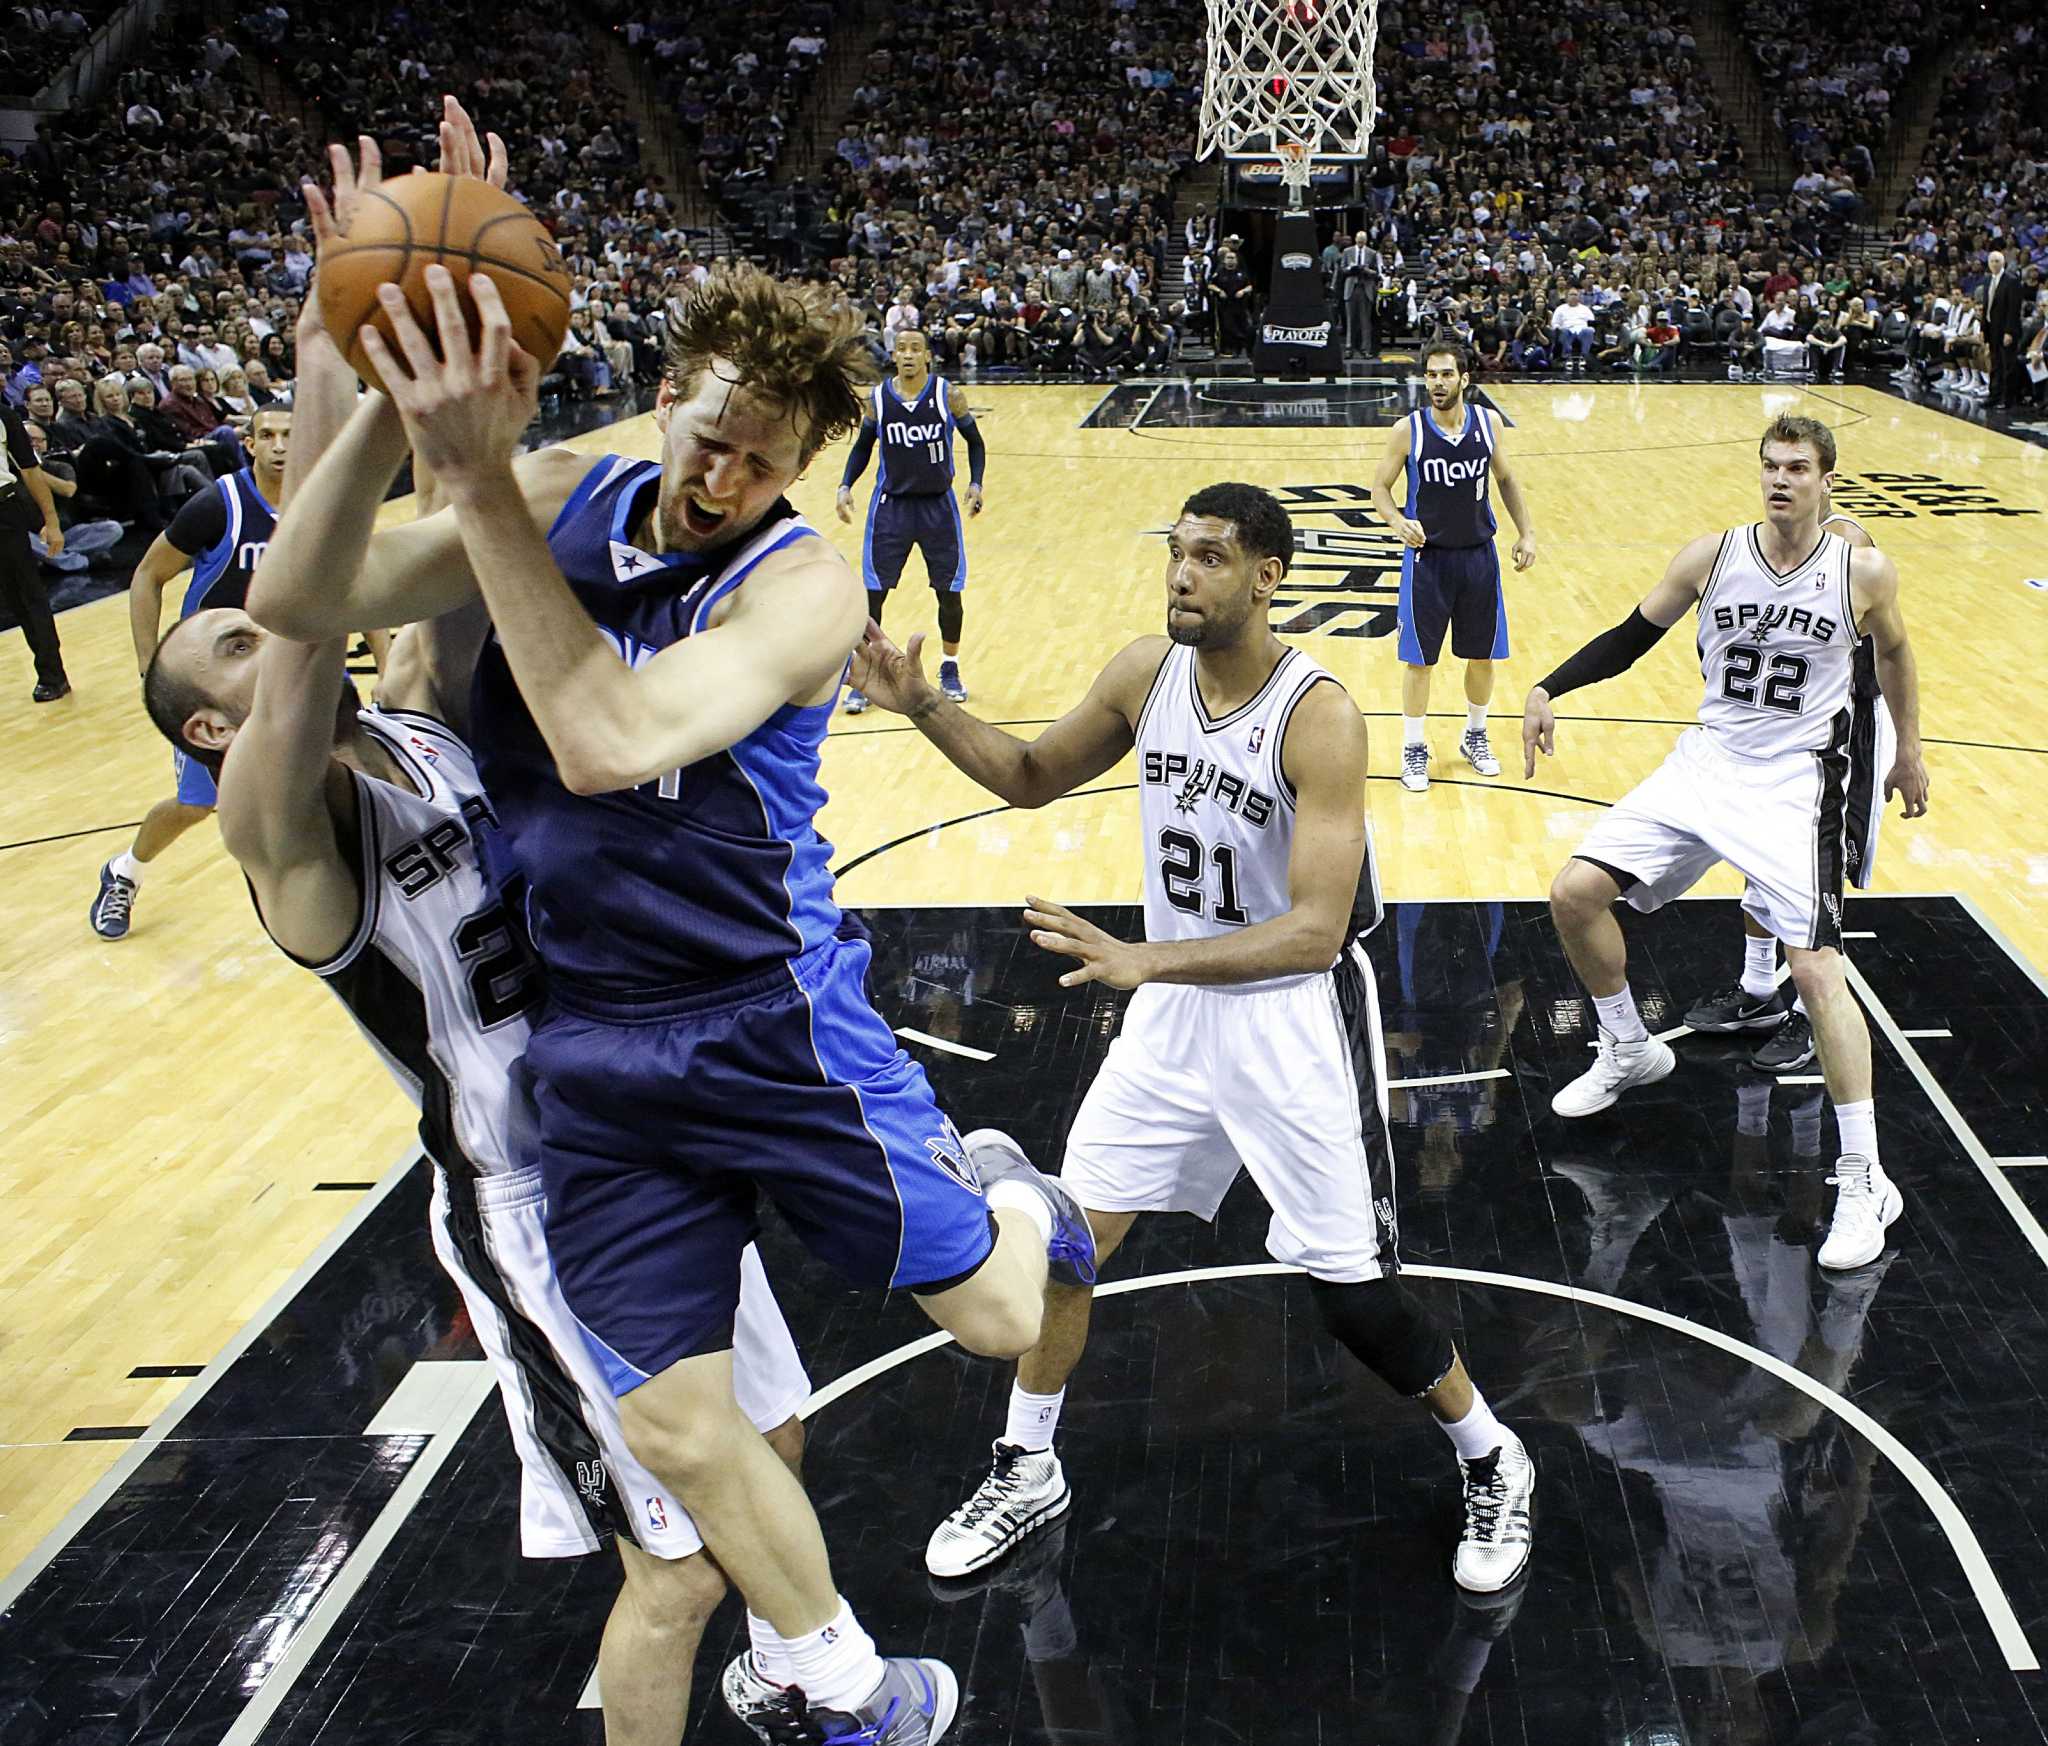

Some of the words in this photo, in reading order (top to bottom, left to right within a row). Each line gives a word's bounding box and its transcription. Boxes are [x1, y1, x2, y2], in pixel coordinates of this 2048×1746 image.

[1271, 329, 1329, 341] PLAYOFFS
[927, 440, 945, 464] 11
[1712, 602, 1838, 645] SPURS
[1721, 643, 1812, 715] 22
[1144, 750, 1277, 829] SPURS
[1157, 824, 1250, 927] 21
[451, 870, 545, 1036] 2
